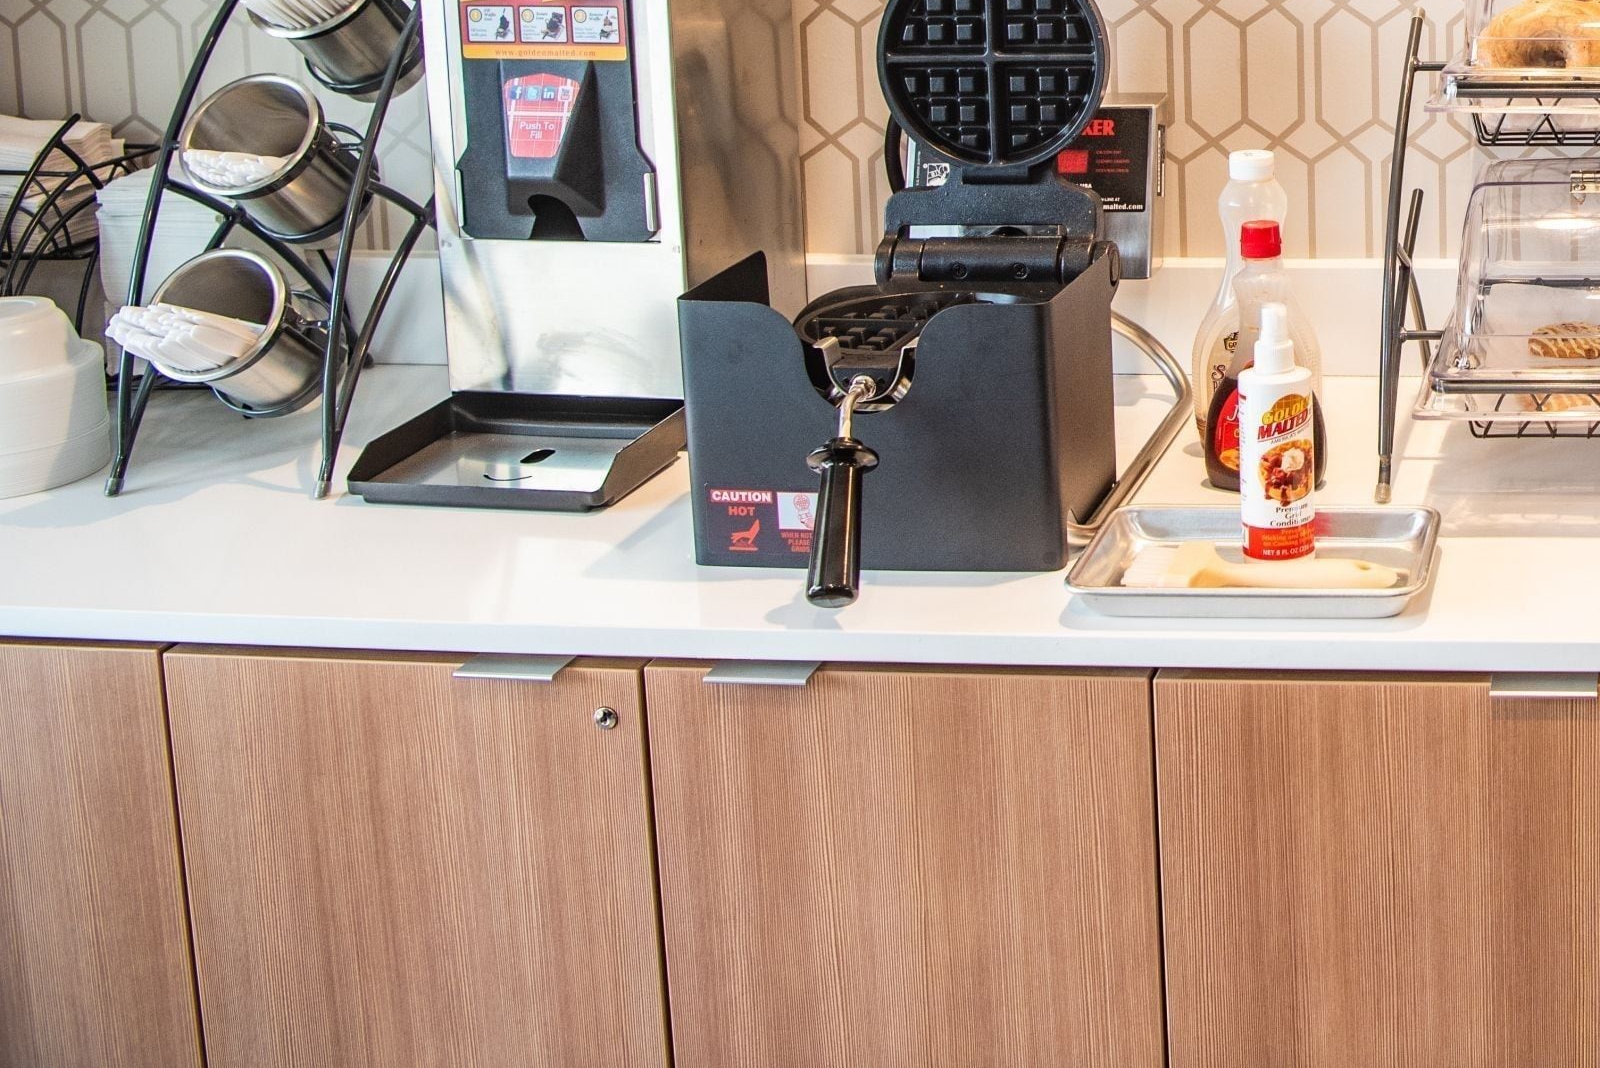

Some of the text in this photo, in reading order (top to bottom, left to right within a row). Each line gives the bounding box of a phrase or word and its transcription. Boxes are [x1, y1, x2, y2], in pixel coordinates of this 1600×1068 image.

[494, 48, 597, 58] www.goldenmalted.com
[543, 88, 555, 99] in
[519, 121, 555, 130] Push To
[530, 130, 543, 139] Fill
[1257, 408, 1309, 440] MALTED
[711, 490, 771, 502] CAUTION
[728, 506, 756, 516] HOT
[788, 538, 811, 546] PLEASE
